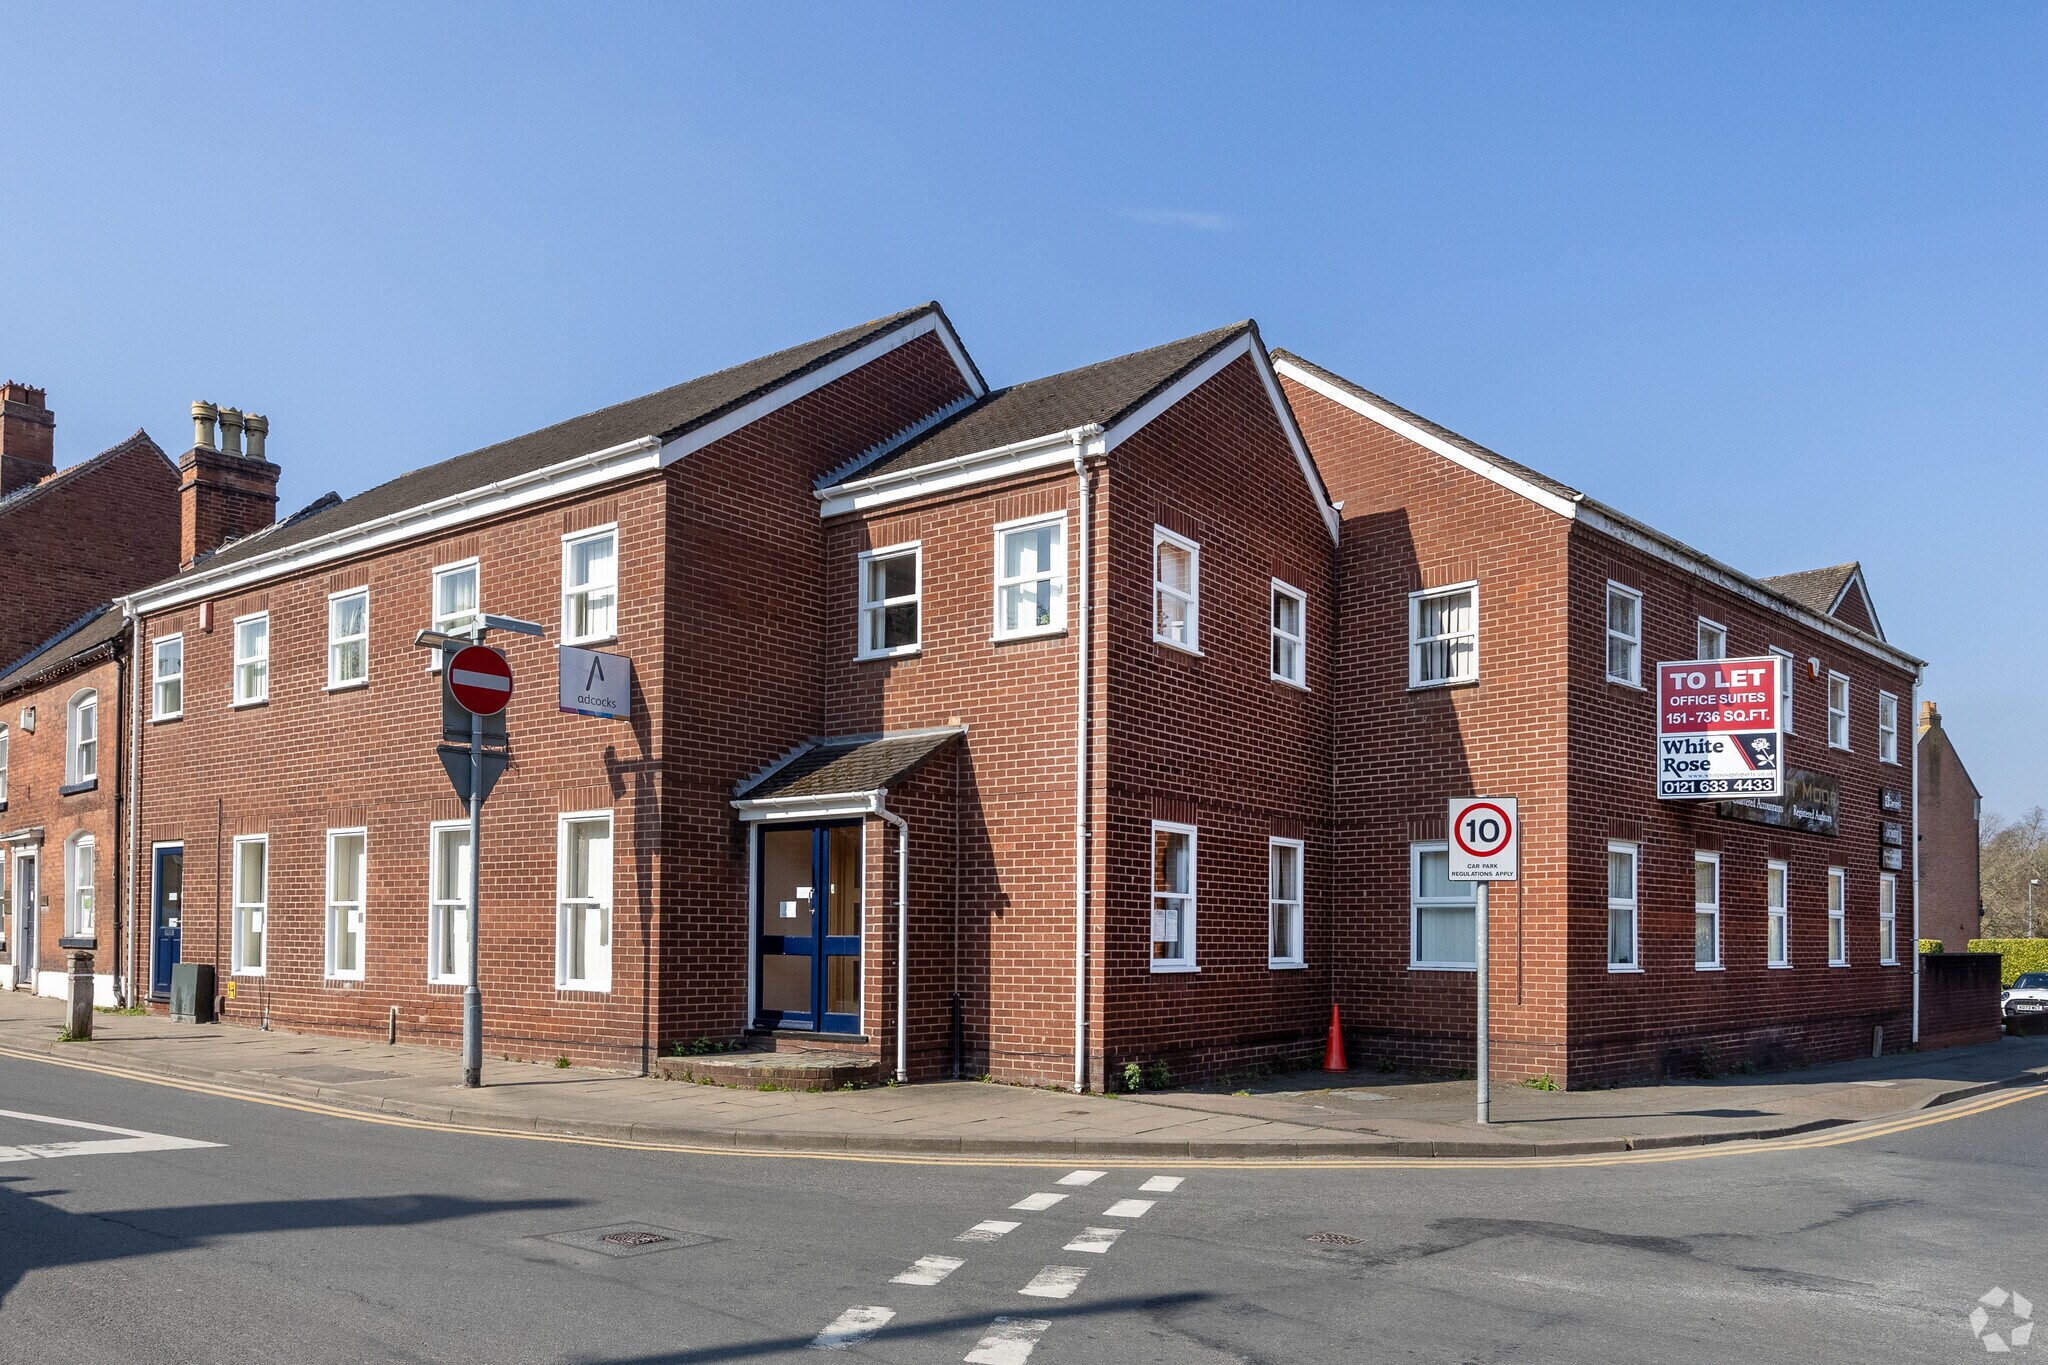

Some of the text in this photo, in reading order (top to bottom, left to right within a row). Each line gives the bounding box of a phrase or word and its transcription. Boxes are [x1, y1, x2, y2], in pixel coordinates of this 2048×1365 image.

[1669, 669, 1766, 690] TO LET
[577, 694, 617, 709] adcocks
[1669, 692, 1766, 706] OFFICE SUITES
[1723, 709, 1770, 723] SQ.FT.
[1662, 738, 1724, 755] White
[1662, 757, 1711, 778] Rose
[1663, 781, 1695, 793] 0121
[1699, 780, 1729, 792] 633
[1733, 778, 1773, 791] 4433
[1466, 818, 1500, 843] 10
